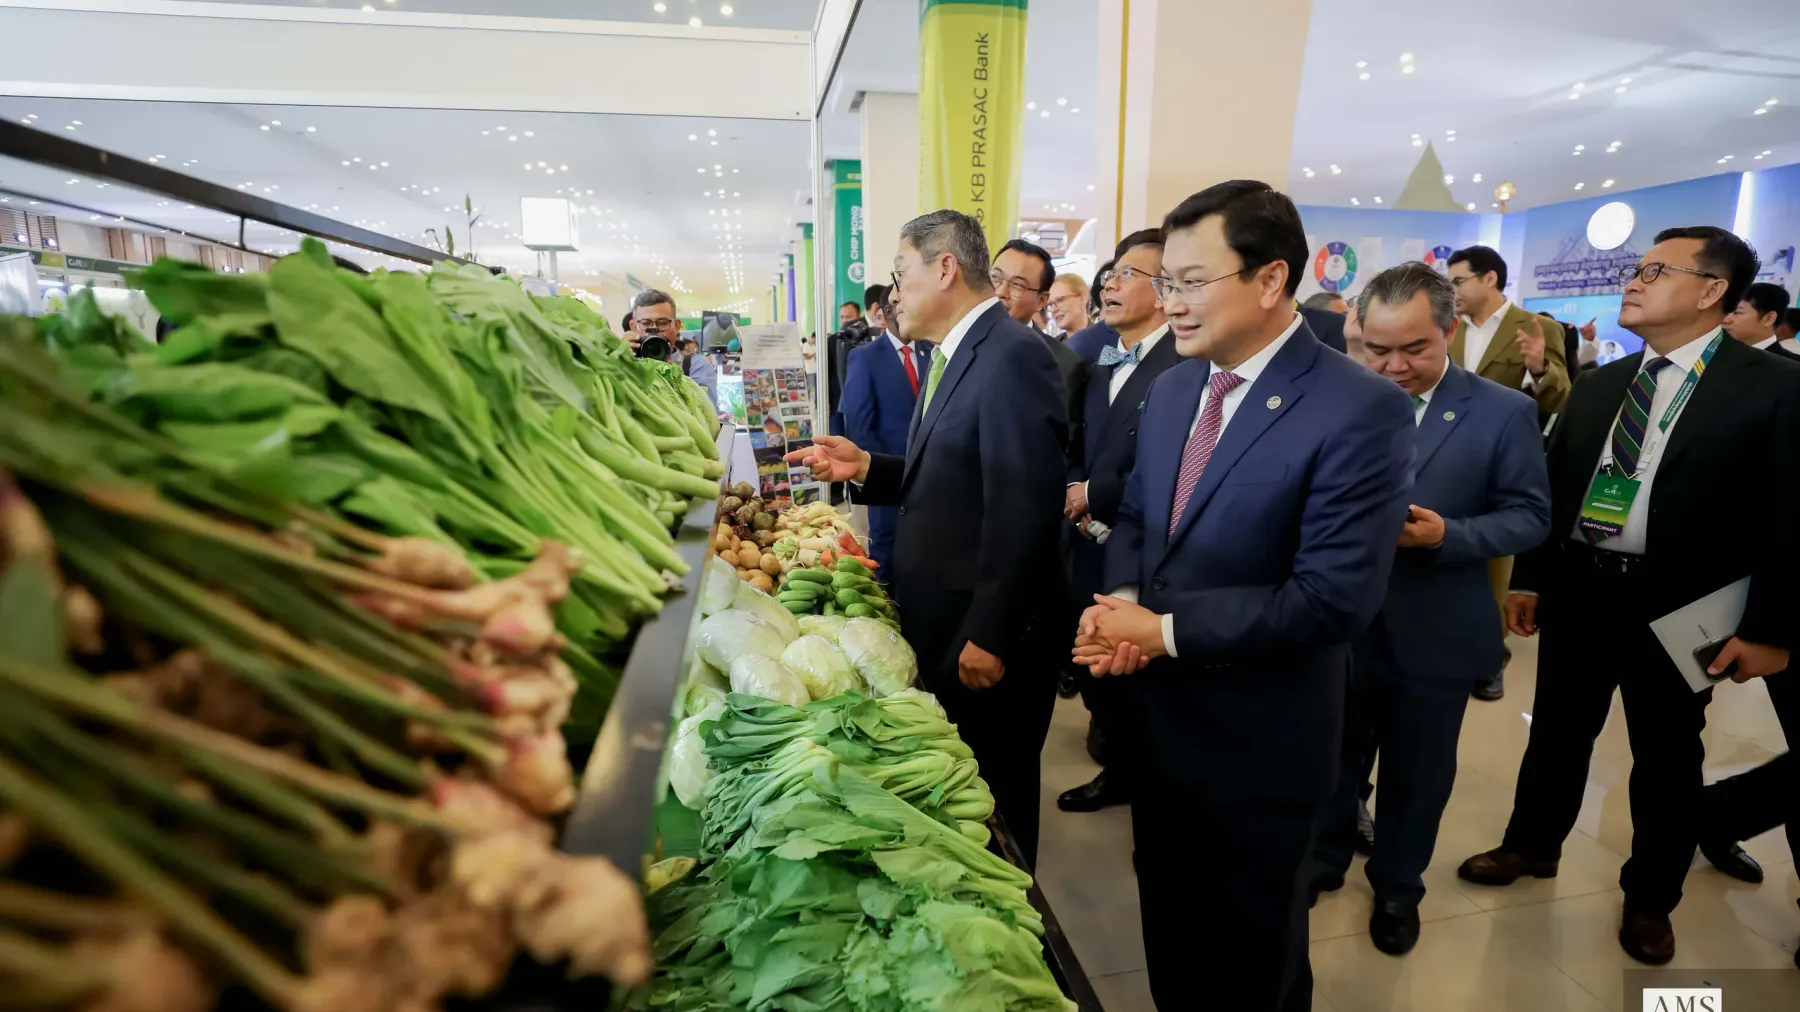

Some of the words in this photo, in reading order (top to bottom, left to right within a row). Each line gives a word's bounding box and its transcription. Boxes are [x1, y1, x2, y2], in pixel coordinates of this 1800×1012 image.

[974, 31, 989, 81] Bank
[971, 87, 988, 168] PRASAC
[971, 173, 985, 202] KB
[1583, 521, 1618, 533] PARTICIPANT
